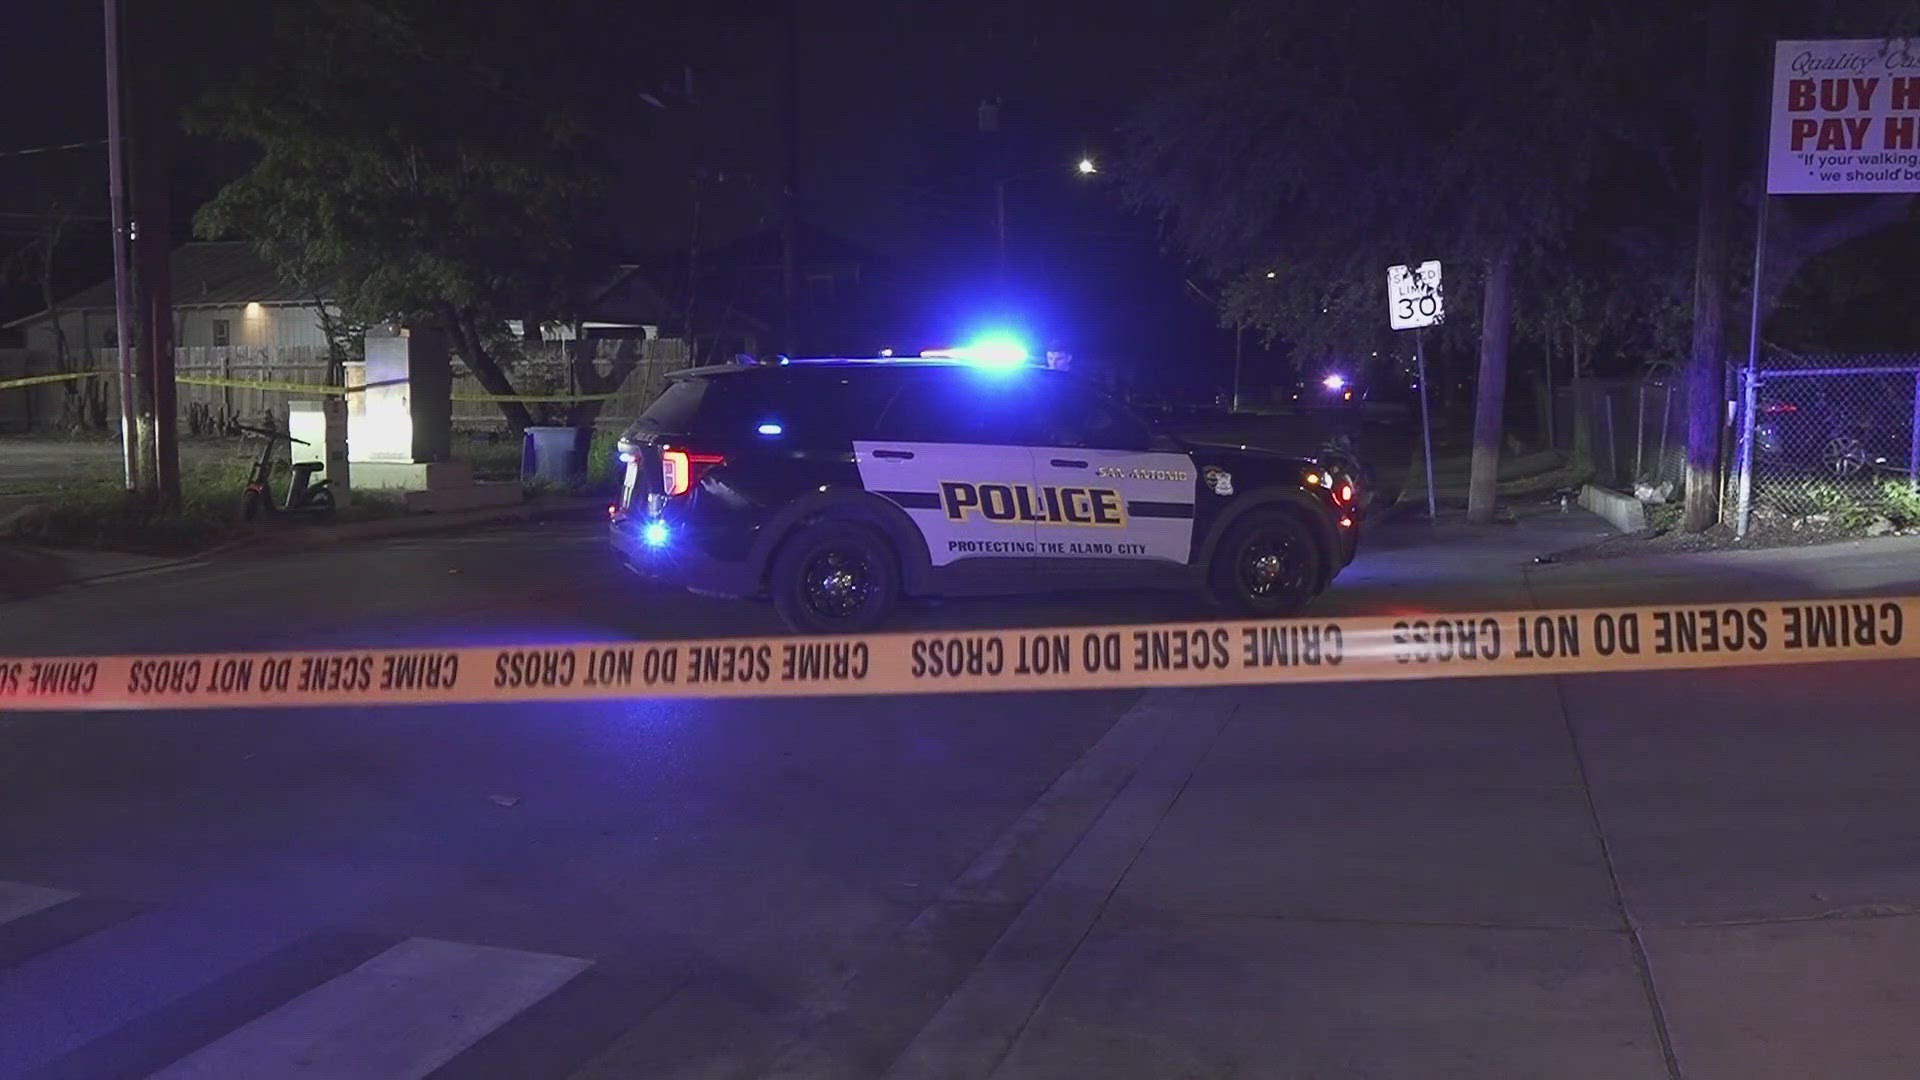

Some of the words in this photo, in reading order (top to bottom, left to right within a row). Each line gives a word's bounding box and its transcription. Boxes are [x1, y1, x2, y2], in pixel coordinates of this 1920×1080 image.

[1791, 51, 1875, 76] Quality
[1788, 77, 1880, 112] BUY
[1791, 117, 1872, 151] PAY
[1884, 117, 1920, 150] H
[1819, 156, 1854, 169] your
[1820, 172, 1841, 181] we
[1846, 169, 1900, 181] should
[1398, 295, 1437, 320] 30
[1097, 466, 1125, 478] SAN
[1129, 468, 1188, 481] ANTONIO
[939, 481, 1126, 528] POLICE
[948, 541, 1034, 553] PROTECTING
[1040, 542, 1065, 554] THE
[1070, 543, 1113, 554] ALAMO
[1118, 544, 1146, 555] CITY
[1394, 617, 1500, 664] CROSS
[1514, 615, 1580, 659] NOT
[1593, 612, 1640, 656] DO
[1653, 608, 1767, 654] SCENE
[1782, 602, 1904, 649] CRIME
[686, 643, 771, 683] SCENE
[781, 640, 869, 681] CRIME
[911, 636, 1003, 678] CROSS
[1014, 634, 1070, 675] NOT
[1082, 632, 1121, 673] DO
[1133, 628, 1229, 671] SCENE
[1241, 623, 1343, 668] CRIME
[28, 661, 98, 695] CRIME
[128, 660, 200, 694] CROSS
[206, 658, 253, 694] NOT
[259, 657, 292, 693] DO
[297, 655, 373, 692] SCENE
[379, 653, 459, 690] CRIME
[494, 650, 576, 688] CROSS
[583, 648, 634, 687] NOT
[643, 646, 678, 685] DO
